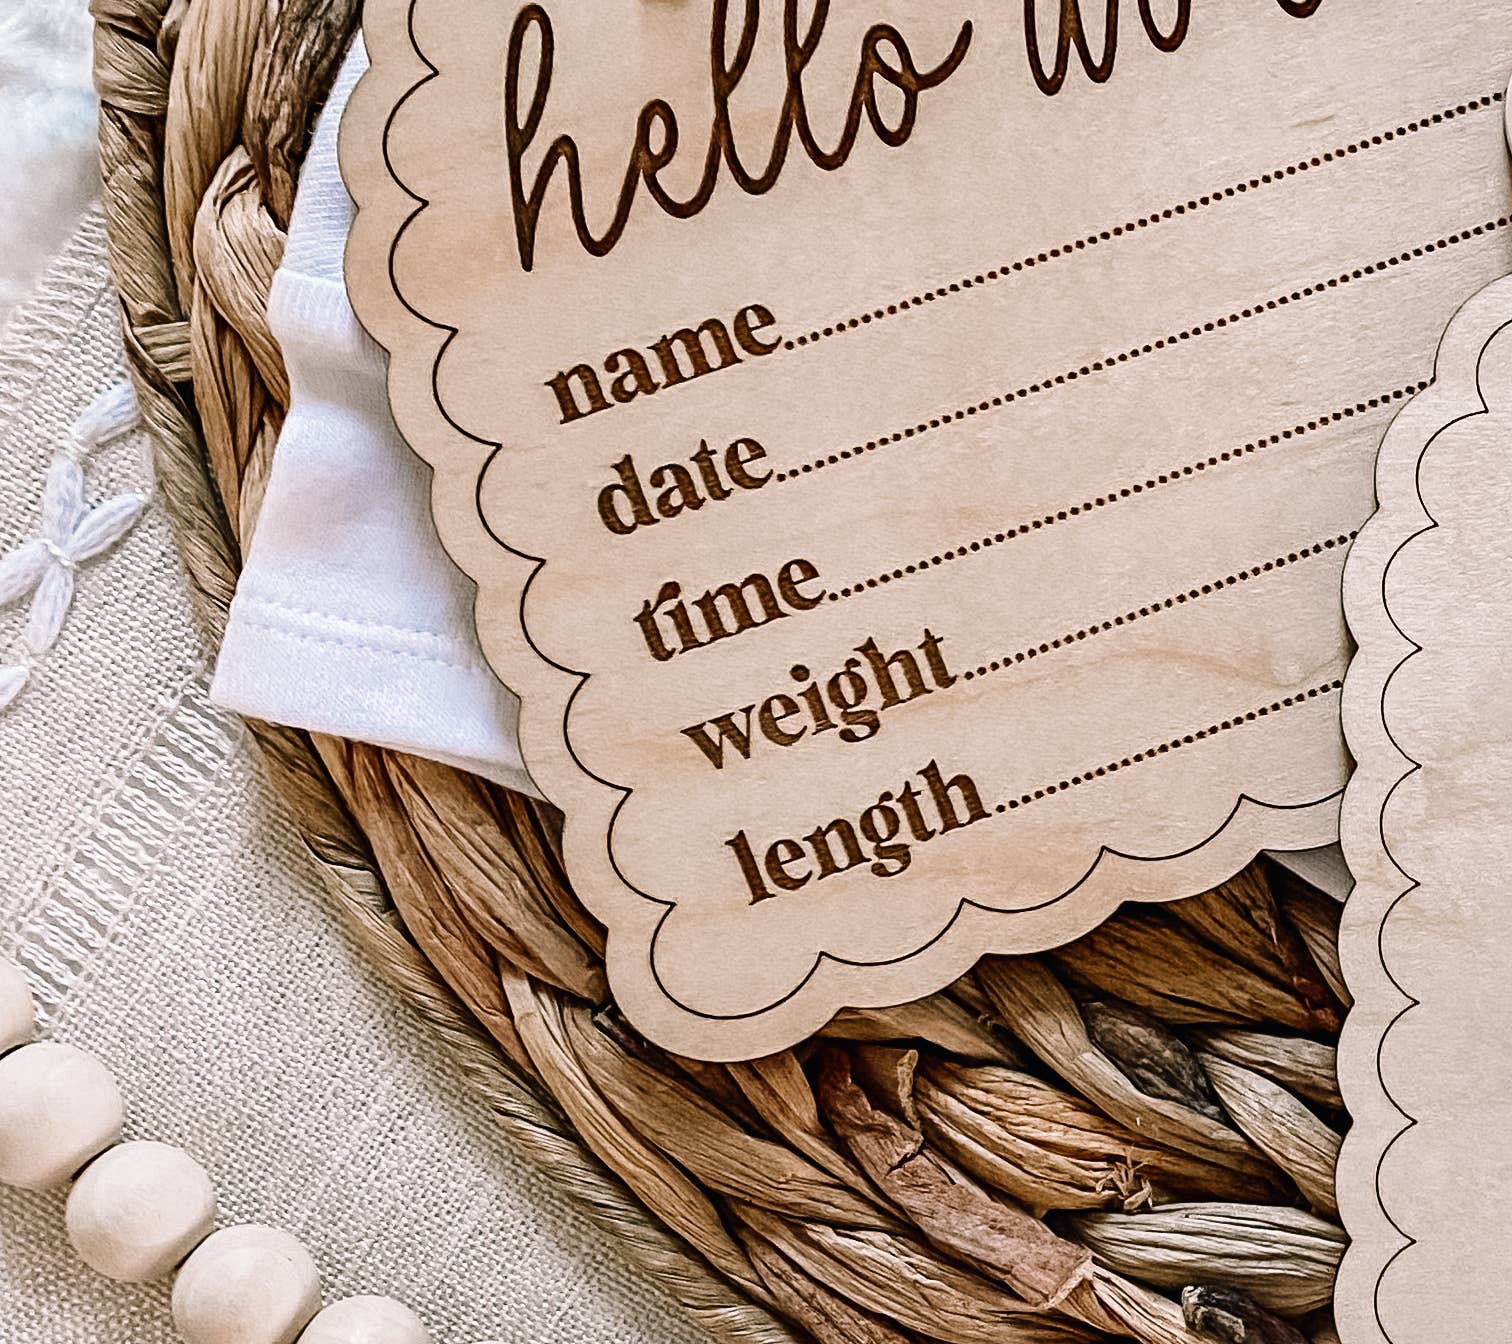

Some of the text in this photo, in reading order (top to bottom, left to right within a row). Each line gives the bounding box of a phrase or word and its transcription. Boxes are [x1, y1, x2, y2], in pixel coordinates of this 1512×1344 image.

[545, 302, 782, 424] name
[596, 436, 774, 535] date
[634, 558, 827, 662] time
[681, 628, 959, 771] weight
[725, 759, 993, 905] length
